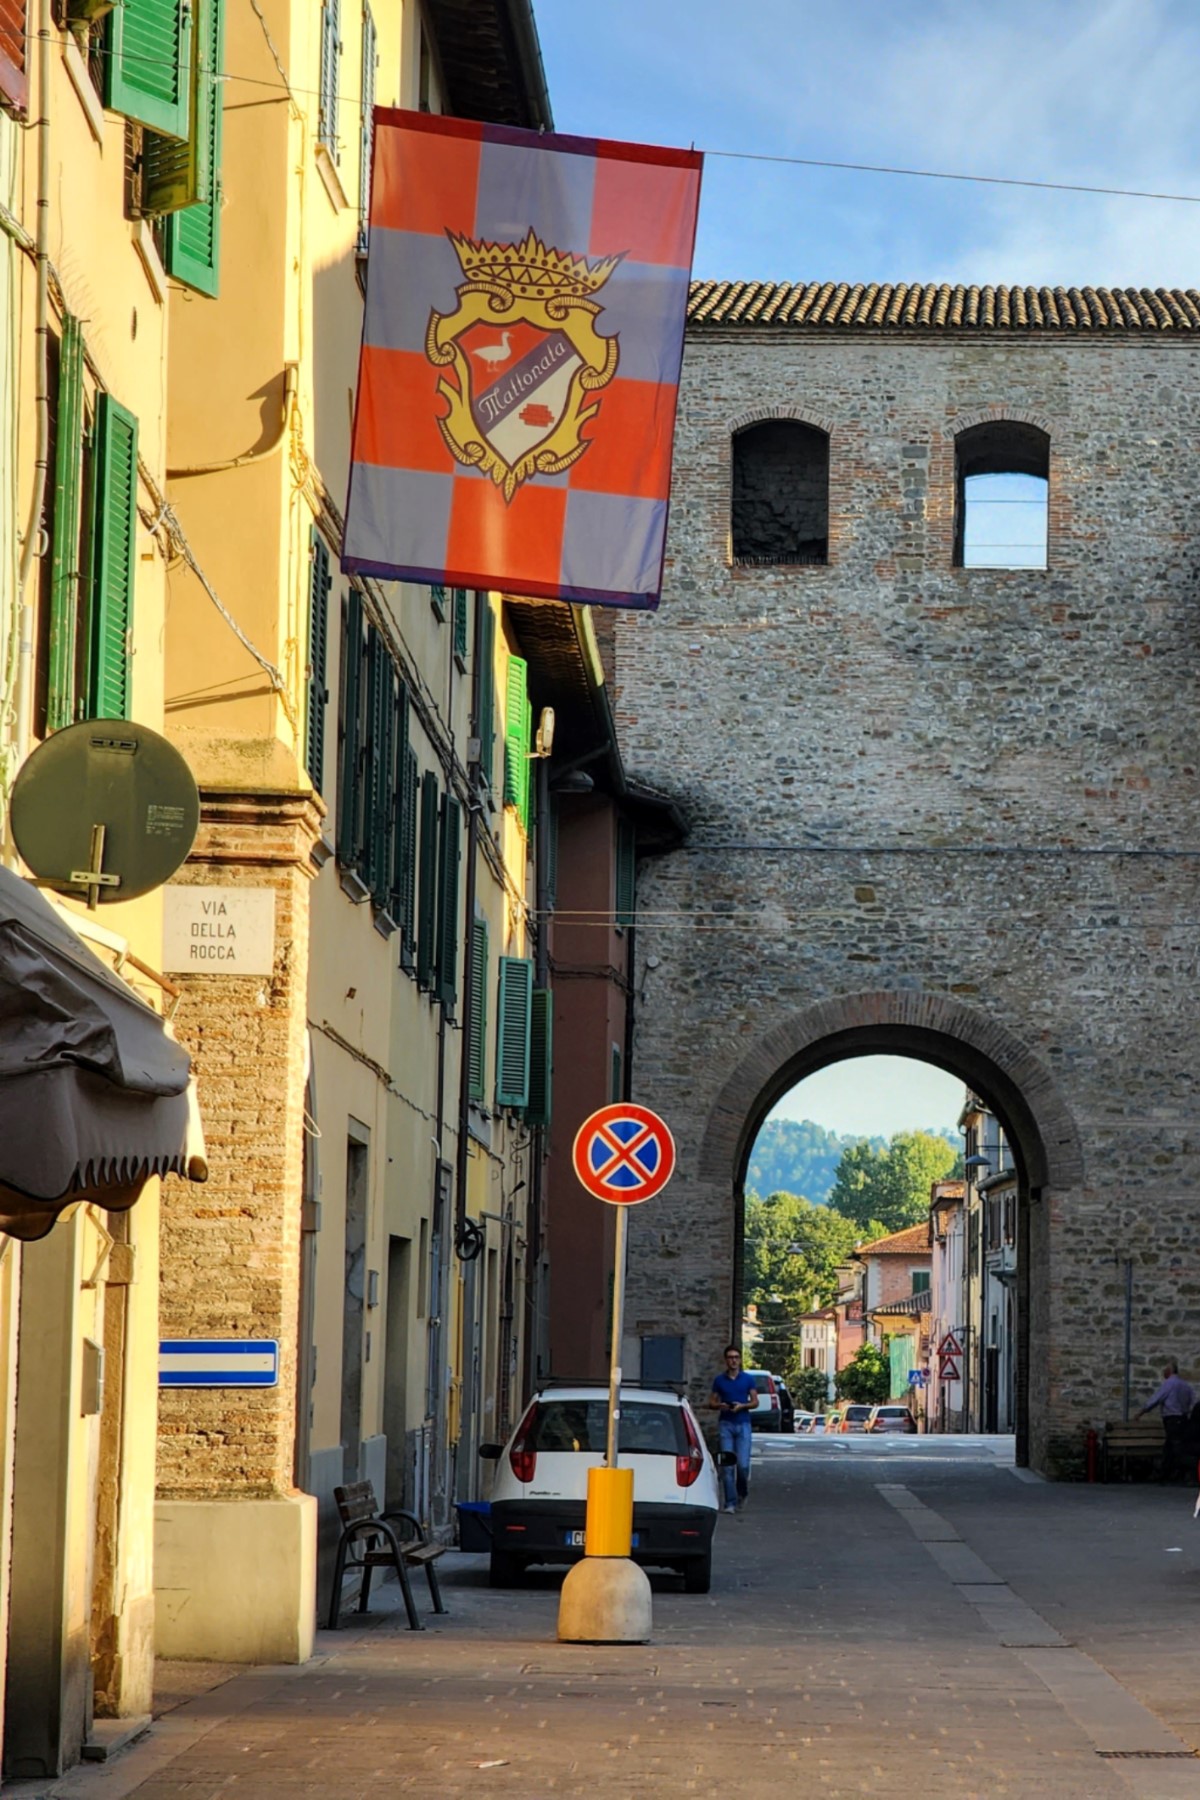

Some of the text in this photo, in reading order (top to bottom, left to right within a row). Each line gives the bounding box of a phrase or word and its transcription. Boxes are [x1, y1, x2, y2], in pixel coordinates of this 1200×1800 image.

[201, 900, 227, 916] VIA
[190, 922, 236, 938] DELLA
[189, 944, 236, 960] ROCCA
